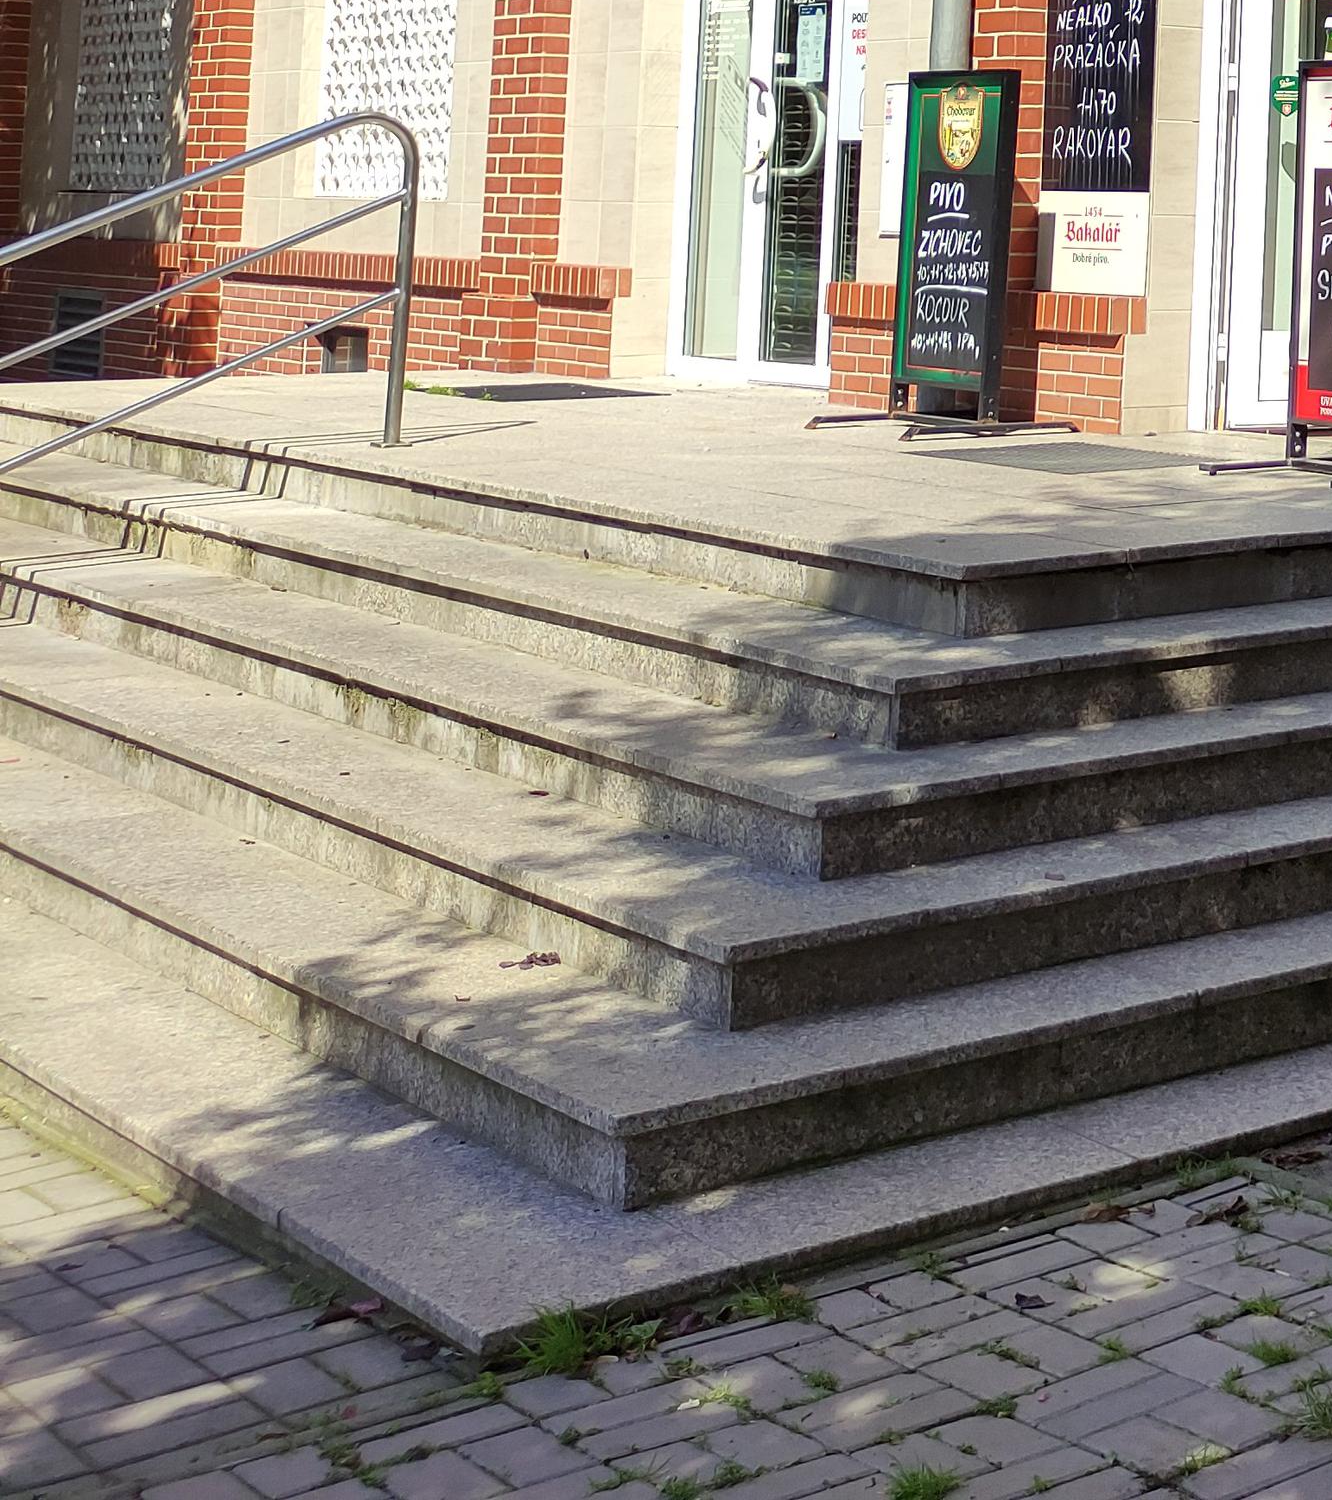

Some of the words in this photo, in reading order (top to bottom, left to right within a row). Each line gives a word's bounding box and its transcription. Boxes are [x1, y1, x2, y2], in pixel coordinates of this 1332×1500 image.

[1056, 1, 1112, 32] NEALKO
[1052, 24, 1141, 73] PRAŽAČKA
[1052, 125, 1132, 168] RAKOVAR
[929, 181, 965, 211] PIVO
[1083, 206, 1103, 219] 1454
[918, 229, 982, 258] ZICHOVEC
[1064, 220, 1121, 244] Bakalář
[1071, 252, 1092, 265] Dobré
[1093, 252, 1110, 267] pivo.
[916, 292, 970, 328] KOCOUR
